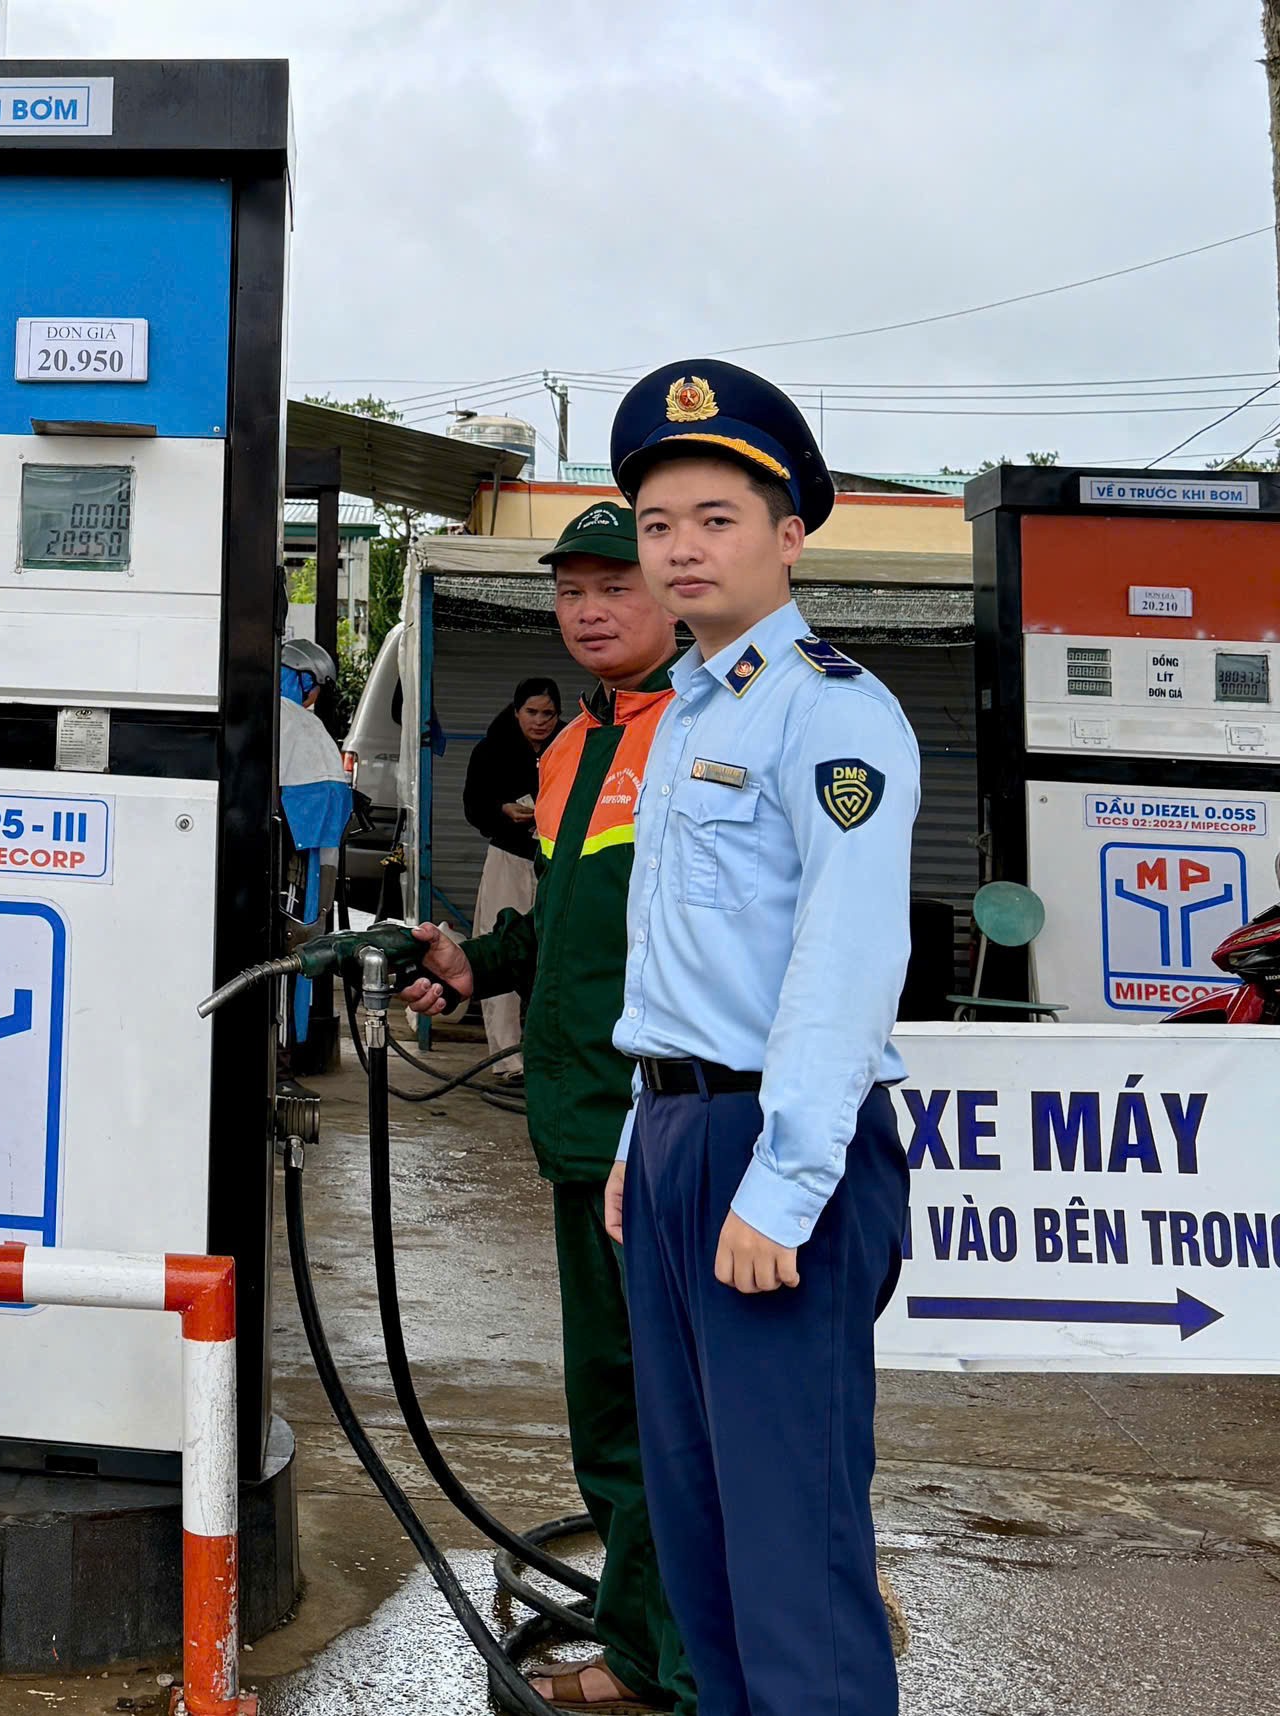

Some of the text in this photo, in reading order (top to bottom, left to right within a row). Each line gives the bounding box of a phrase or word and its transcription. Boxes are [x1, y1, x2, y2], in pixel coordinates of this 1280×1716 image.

[12, 95, 78, 121] BƠM
[37, 348, 123, 373] 20.950
[1097, 483, 1242, 501] VỀ 0 TRƯỚC KHI BƠM
[46, 530, 122, 557] 20.950
[1142, 600, 1178, 611] 20.210
[1157, 671, 1174, 683] LÍT
[1168, 687, 1183, 699] GIÁ
[833, 766, 867, 782] DMS
[1095, 797, 1257, 821] DẦU DIEZEL 0.05S
[1096, 816, 1128, 826] TCCS
[1115, 982, 1226, 1003] MIPECO
[901, 1074, 1208, 1174] XE MÁY
[927, 1194, 1018, 1263] VÀO
[1033, 1196, 1128, 1264] BÊN
